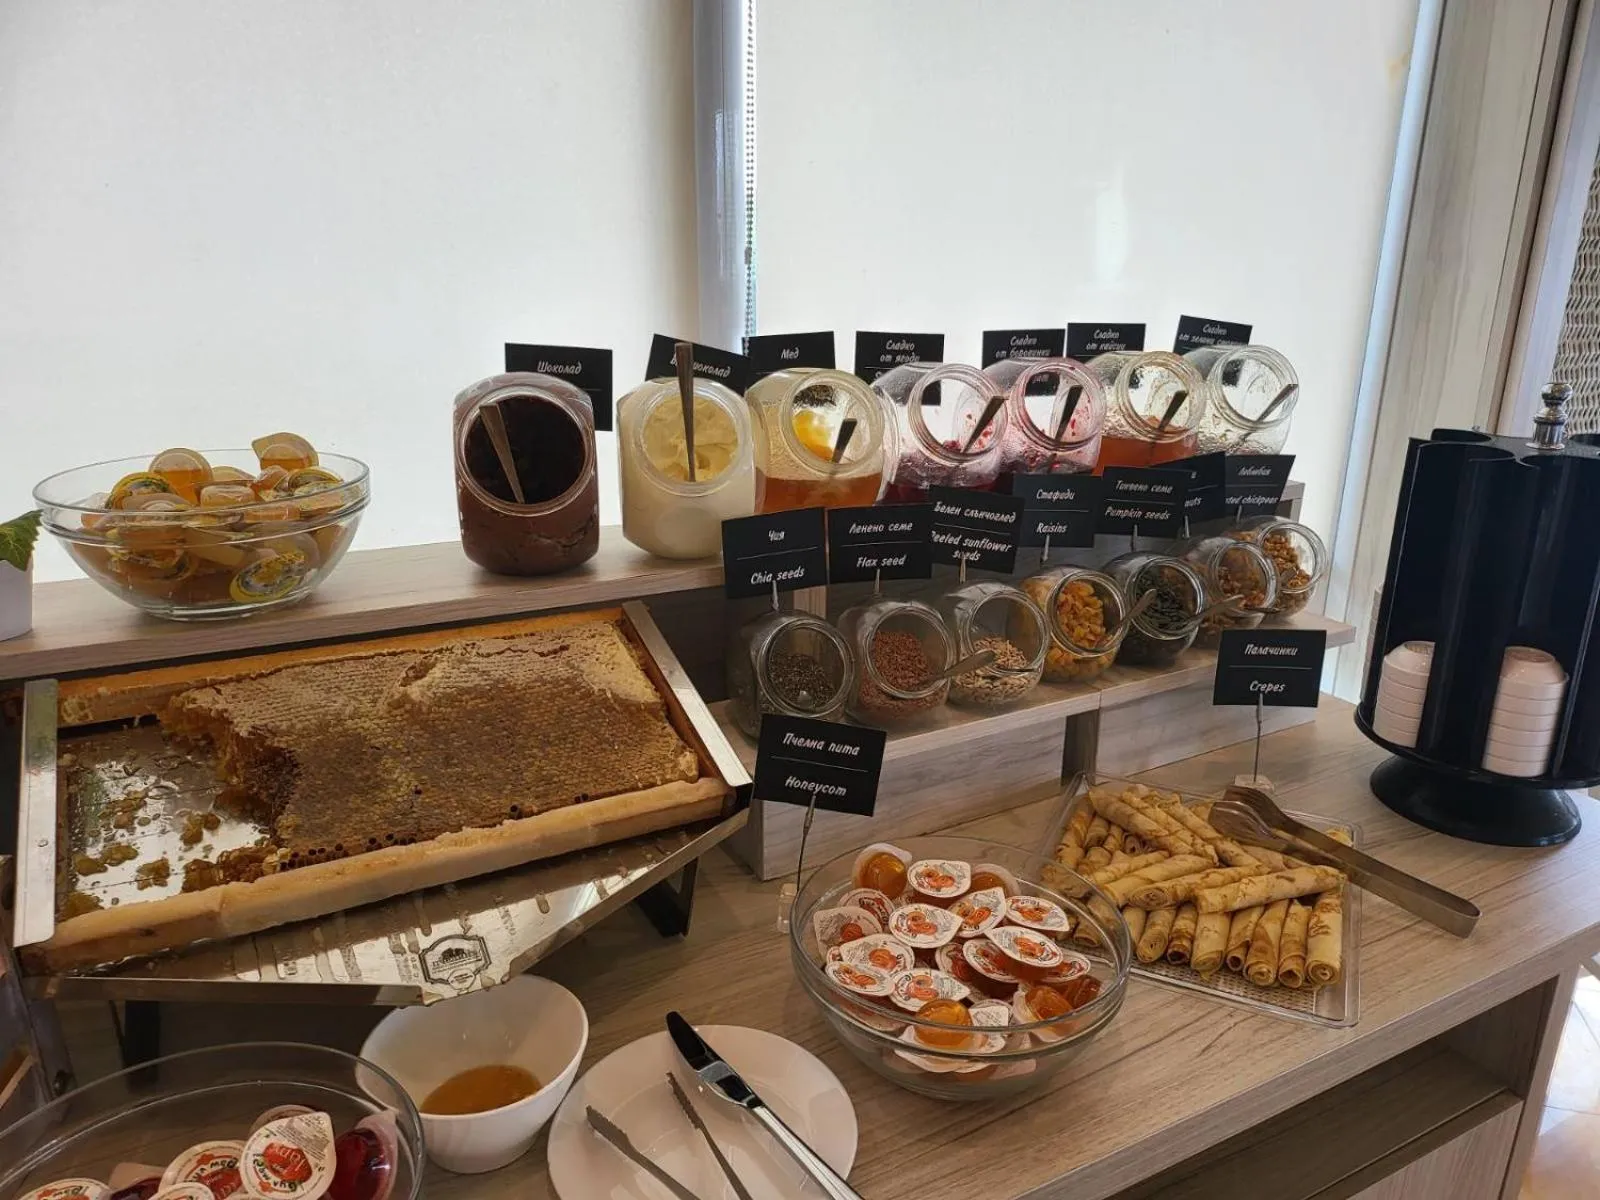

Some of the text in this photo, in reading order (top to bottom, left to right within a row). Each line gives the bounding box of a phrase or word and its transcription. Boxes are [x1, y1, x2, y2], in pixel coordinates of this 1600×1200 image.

[1093, 329, 1120, 339] Сладко
[885, 339, 915, 351] Сладко
[1010, 335, 1037, 347] Сладко
[1086, 343, 1098, 351] от
[781, 347, 800, 360] Мед
[880, 354, 893, 363] от
[995, 351, 1007, 359] от
[537, 360, 582, 375] Шоколад
[1036, 488, 1075, 502] Стафиди
[933, 501, 1016, 523] Белен слънчоглед
[1104, 506, 1172, 521] Pumpkin seeds
[849, 521, 913, 535] Ленено семе
[1035, 522, 1068, 534] Raisins
[768, 529, 785, 542] Чия
[962, 536, 1012, 552] sunflower
[856, 555, 906, 568] Flax seed
[750, 566, 805, 585] Chia seeds
[1244, 643, 1298, 656] Палачинки
[1249, 680, 1286, 694] Crepes
[783, 733, 860, 756] Пчелна пита
[785, 776, 847, 796] Honeycom
